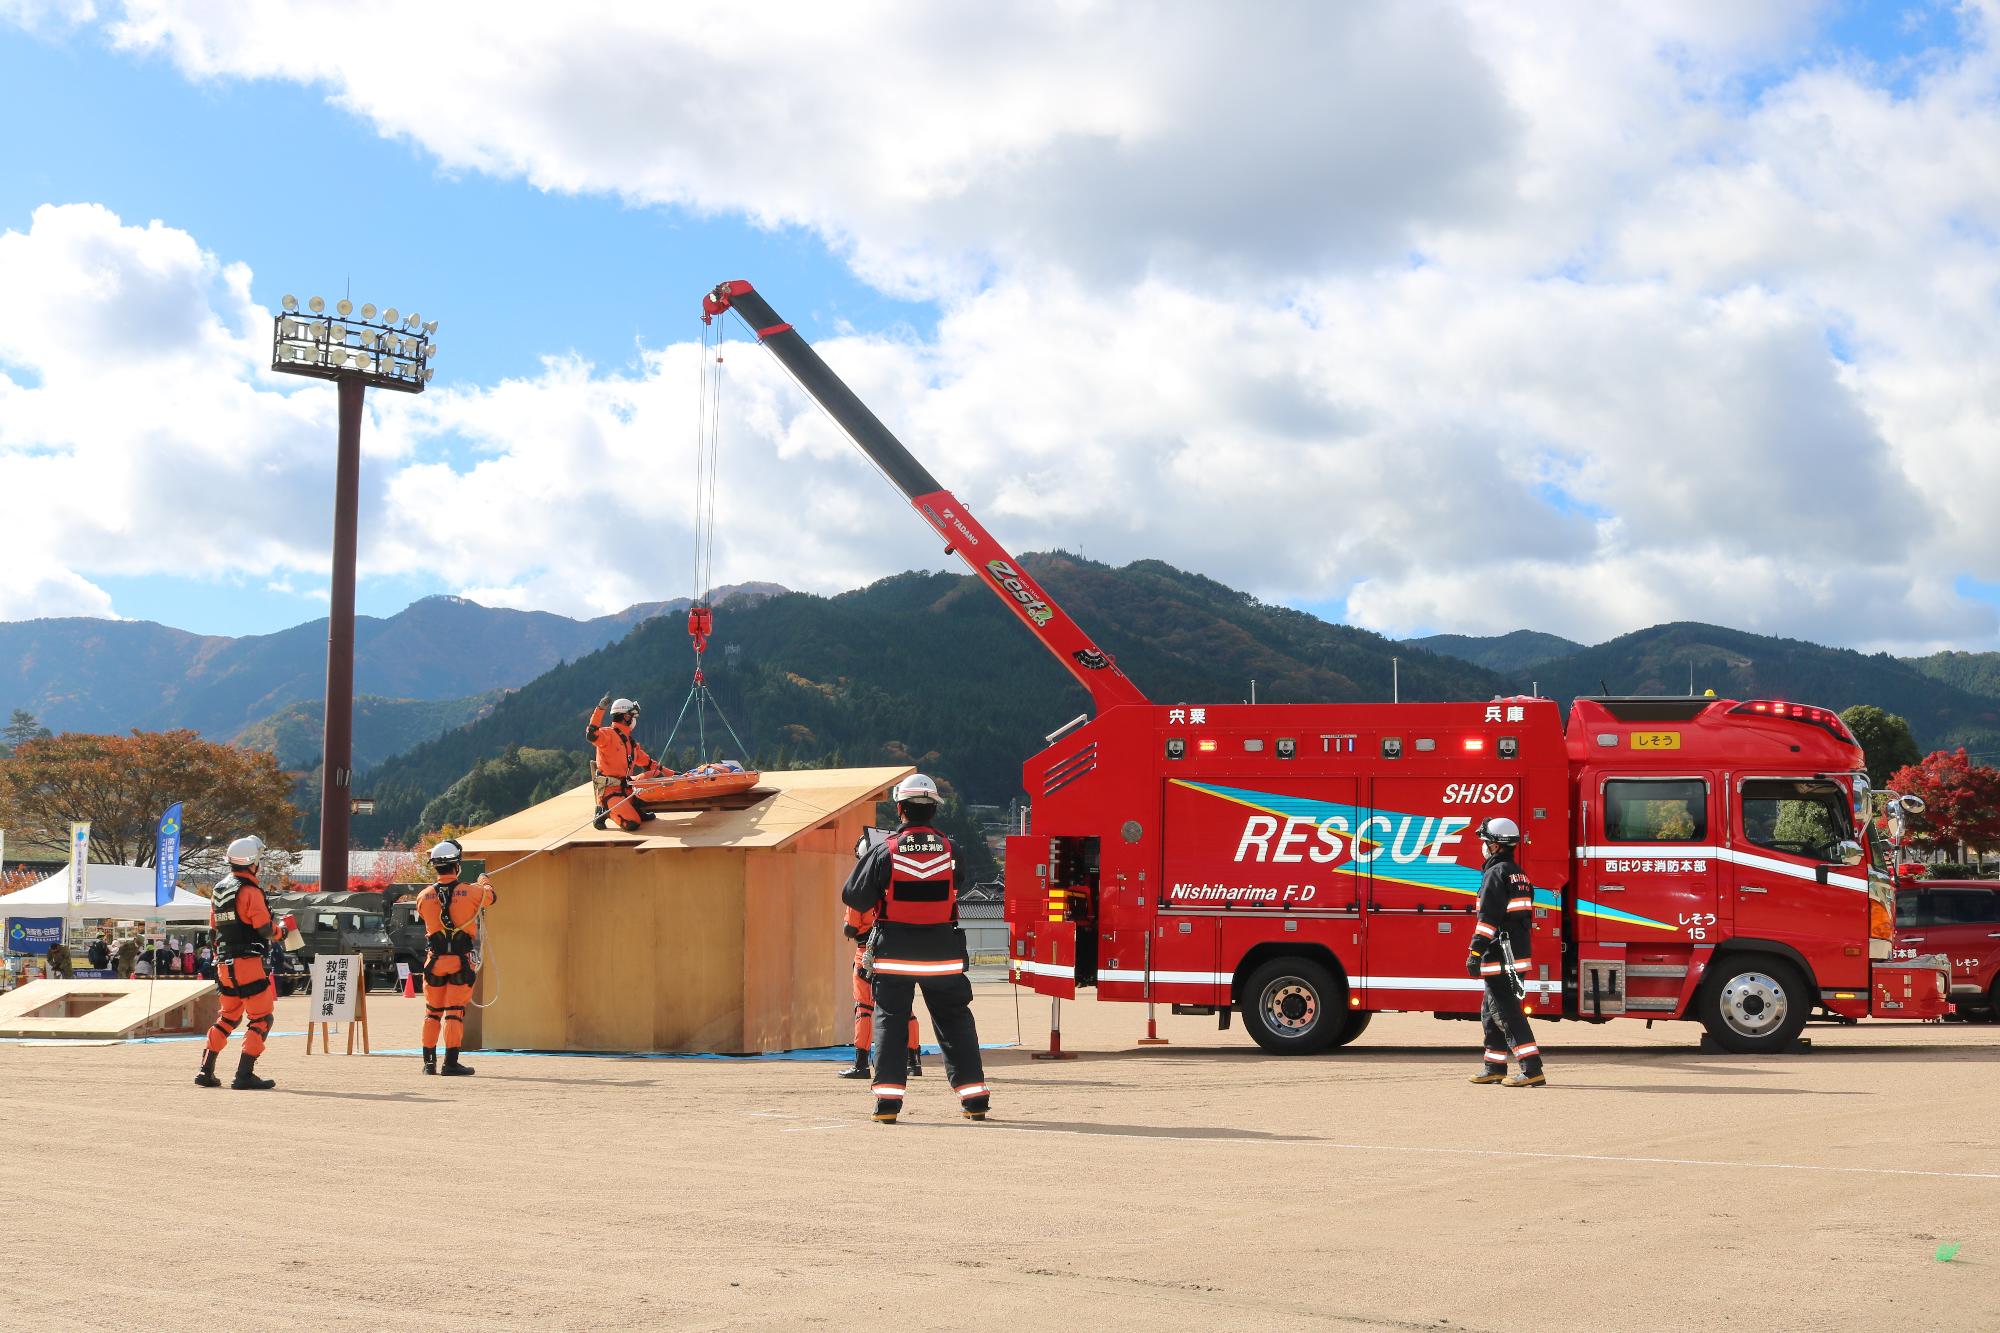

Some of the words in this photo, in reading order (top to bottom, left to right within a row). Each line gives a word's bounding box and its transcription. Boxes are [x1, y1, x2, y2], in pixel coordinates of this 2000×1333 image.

[953, 518, 979, 545] TADANO
[984, 560, 1050, 612] Zest
[1027, 608, 1046, 628] eco
[1170, 709, 1206, 725] 宍粟
[1485, 706, 1524, 722] 兵庫
[1639, 735, 1673, 746] しそう
[1443, 783, 1514, 804] SHISO
[1233, 815, 1472, 865] RESCUE
[1605, 860, 1707, 873] 西はりま消防本部
[1170, 883, 1278, 900] Nishiharima
[1283, 885, 1316, 901] F.D
[1679, 913, 1716, 926] しそう
[1687, 928, 1706, 940] 15
[1956, 958, 1979, 967] しそう
[1966, 967, 1970, 975] 1
[321, 960, 338, 1017] 救出訓練
[335, 958, 349, 1005] 倒壊家屋
